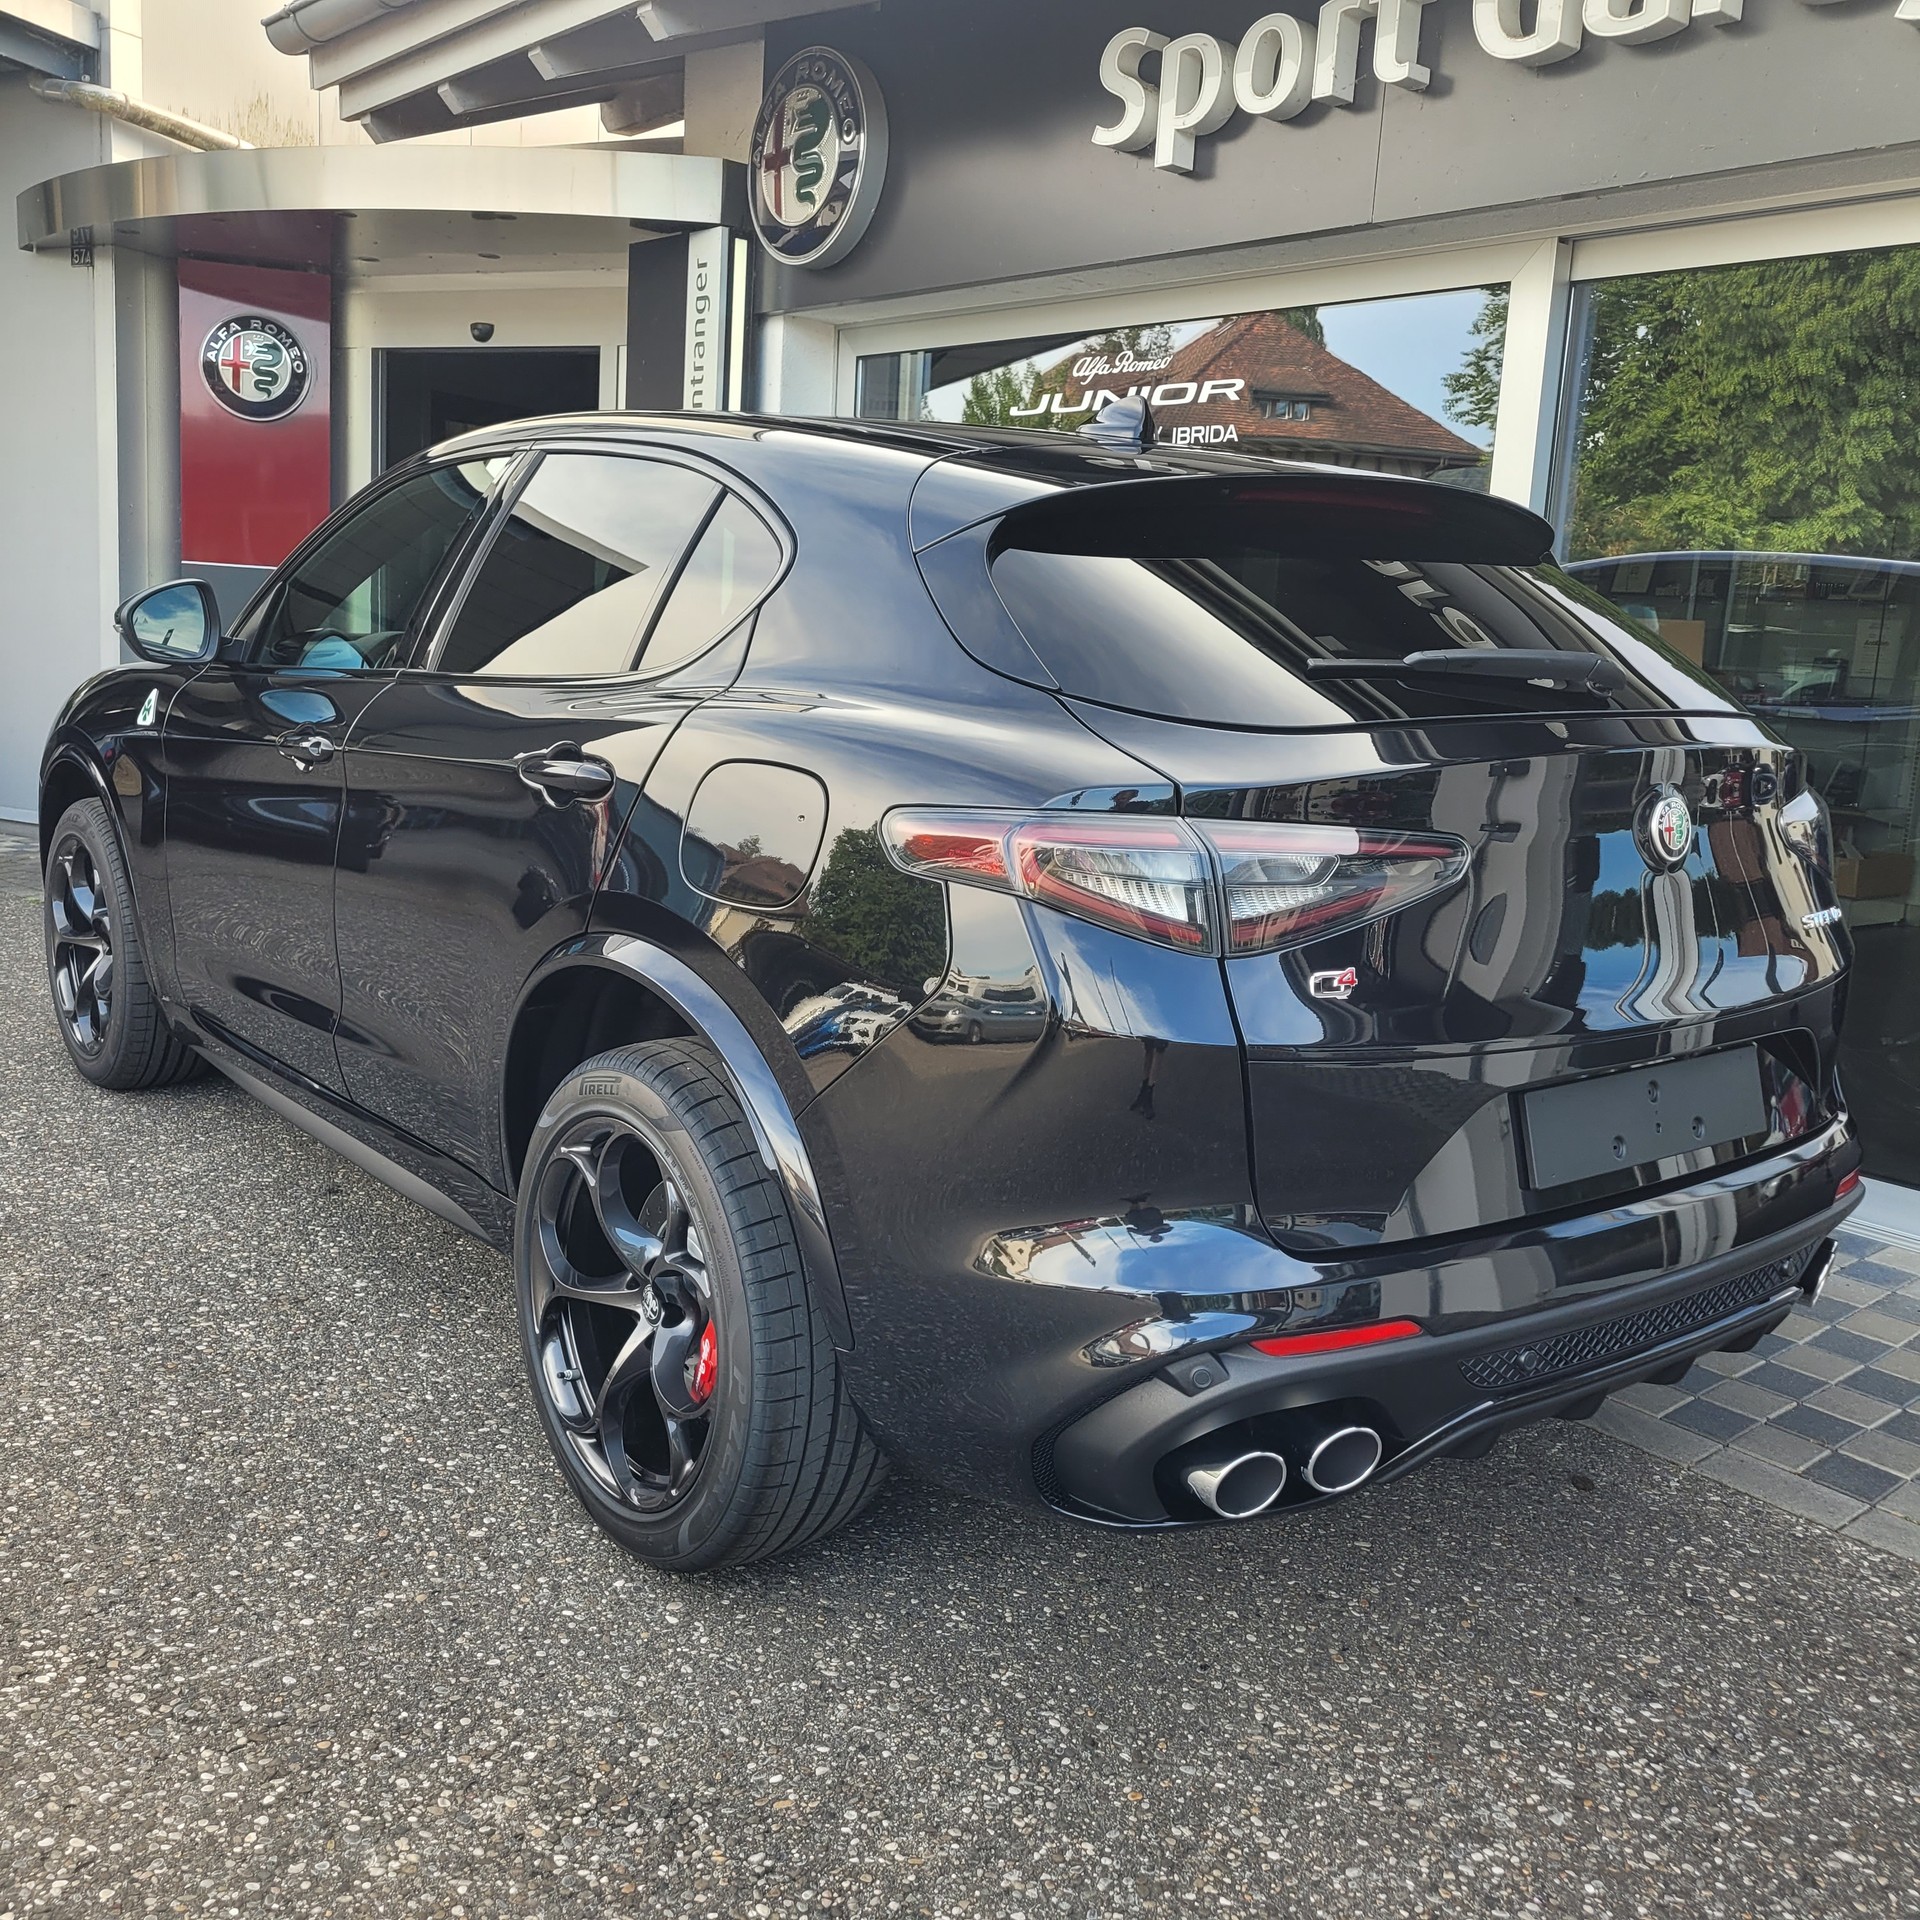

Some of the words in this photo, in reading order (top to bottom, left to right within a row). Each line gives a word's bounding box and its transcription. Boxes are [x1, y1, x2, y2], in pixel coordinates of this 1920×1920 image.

[1091, 0, 1430, 174] Sport
[752, 82, 788, 168] ALFA
[796, 60, 858, 145] ROMEO
[73, 249, 91, 264] 57A
[206, 321, 242, 363] ALFA
[249, 319, 304, 374] ROMEO
[1072, 354, 1113, 385] Alfa
[1111, 350, 1174, 375] Romeo
[1171, 424, 1239, 445] IBRIDA
[578, 1075, 622, 1096] PIRELLI
